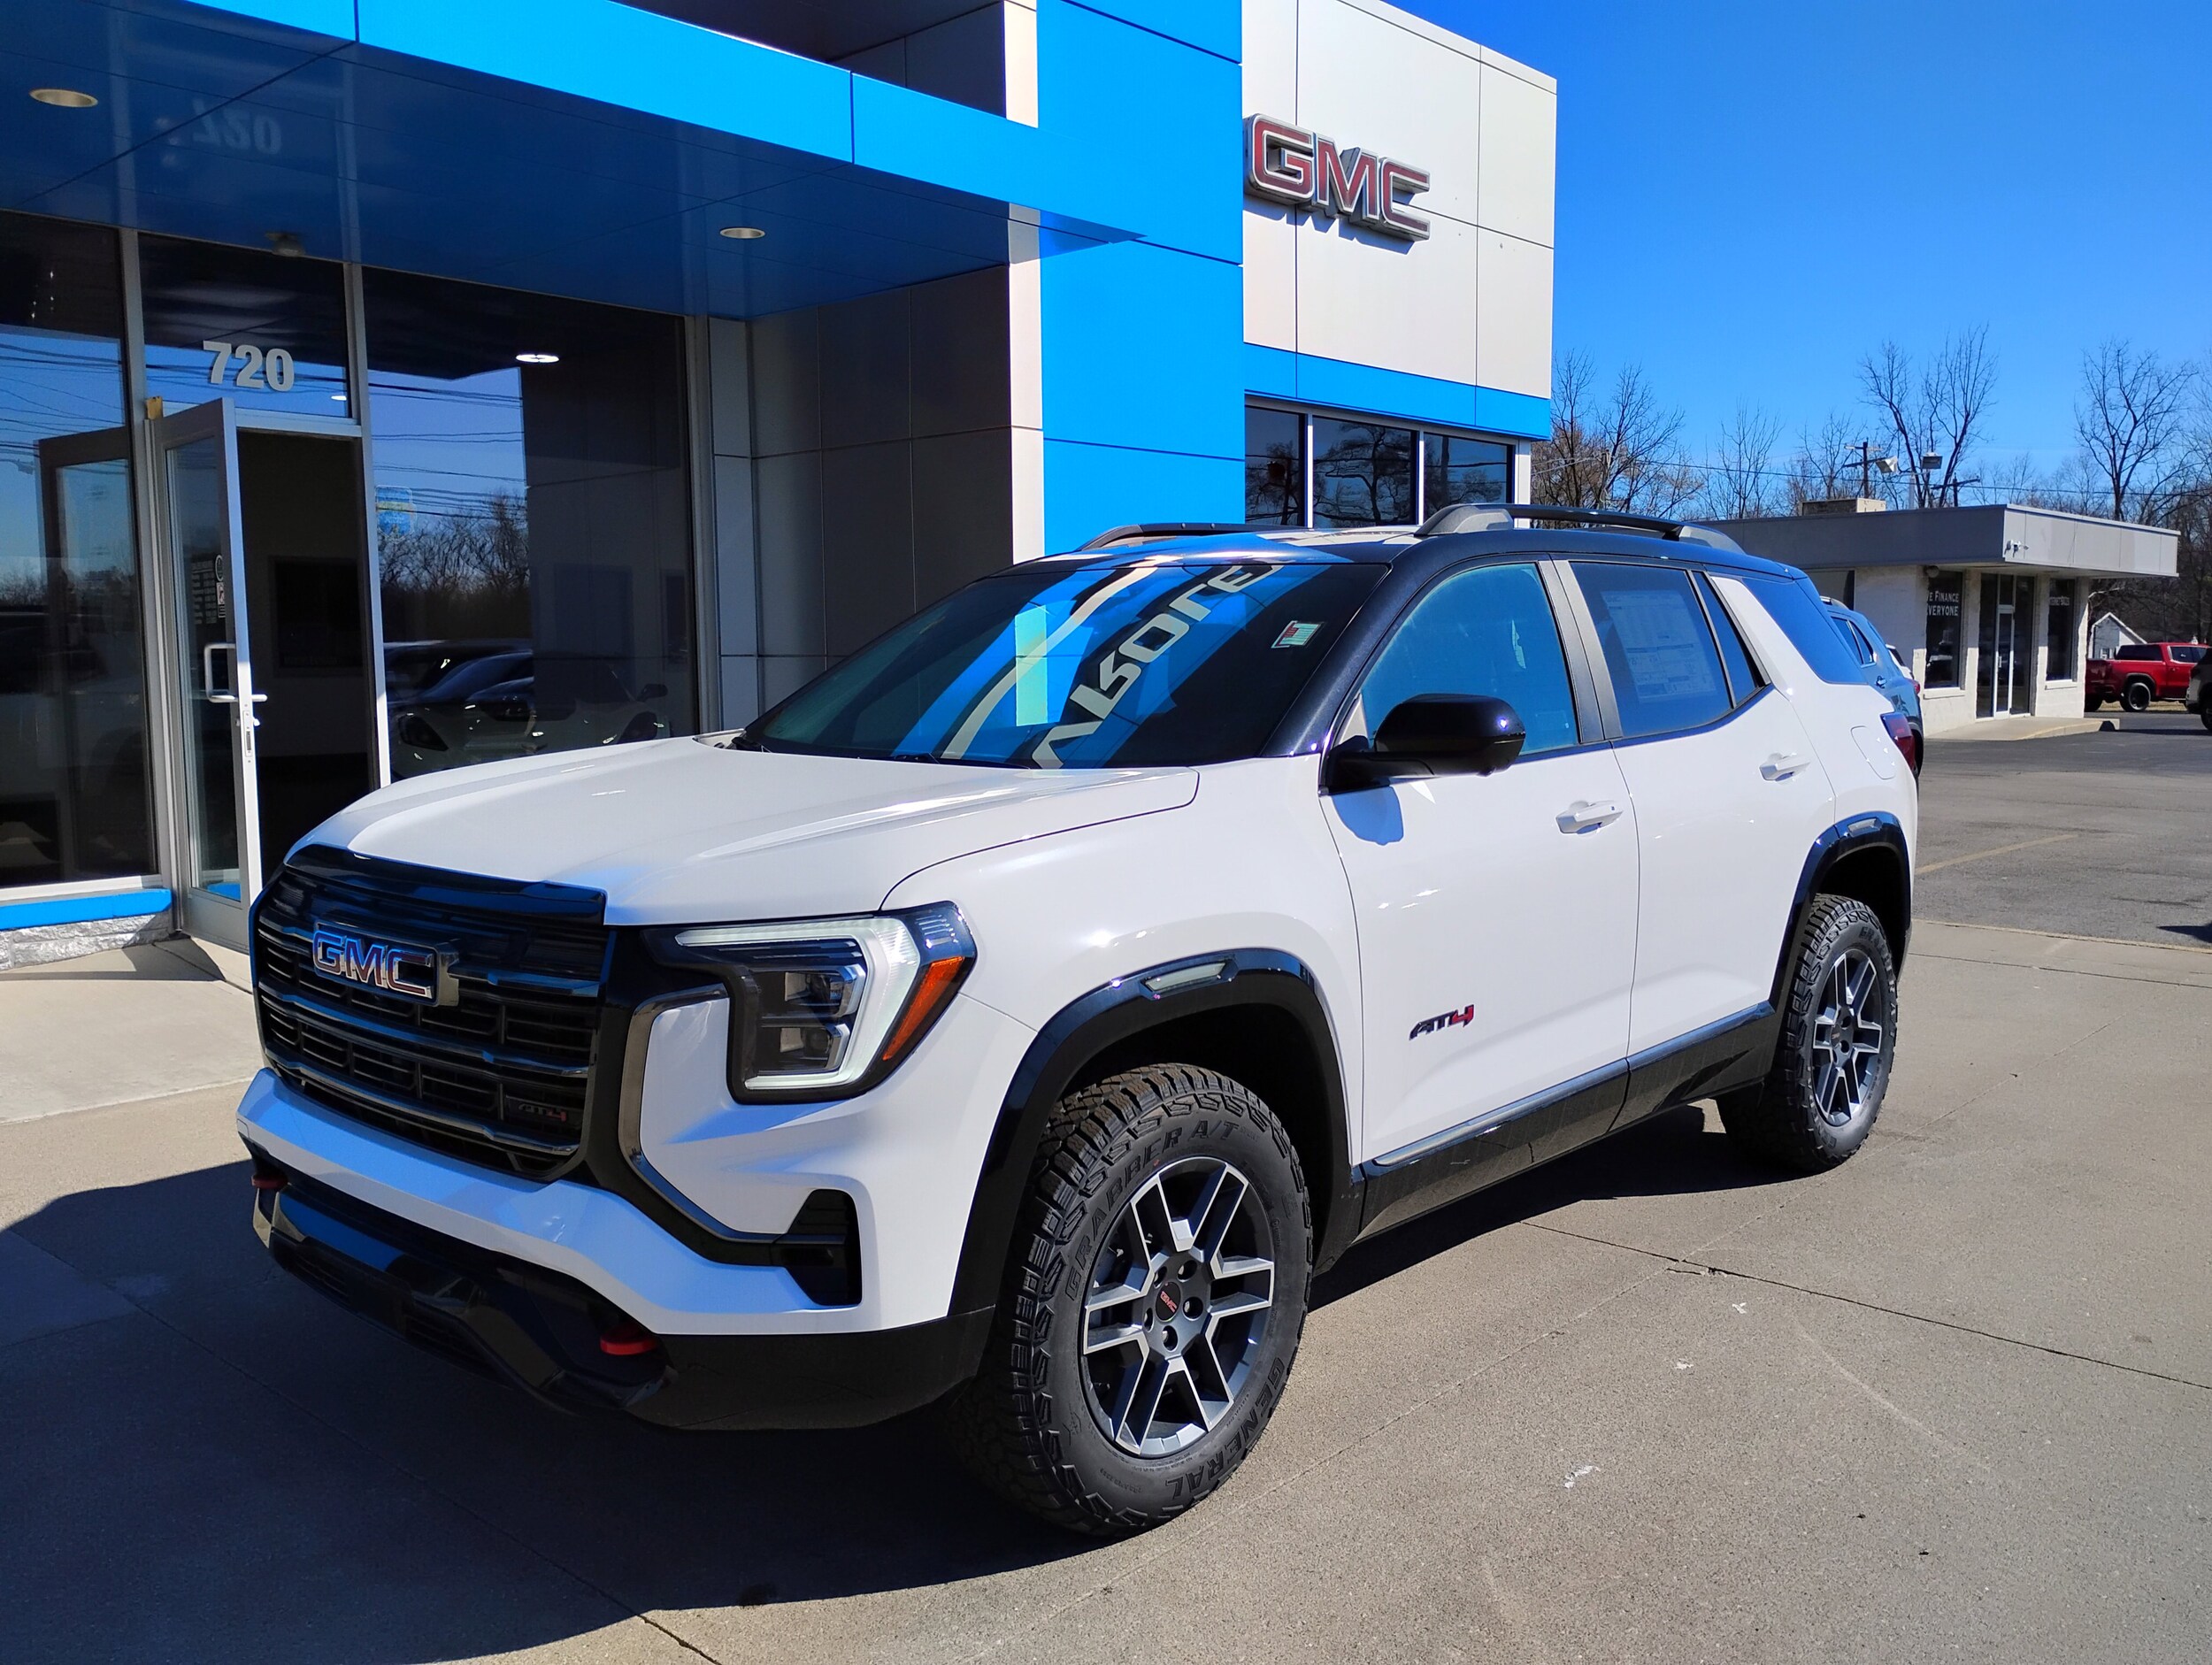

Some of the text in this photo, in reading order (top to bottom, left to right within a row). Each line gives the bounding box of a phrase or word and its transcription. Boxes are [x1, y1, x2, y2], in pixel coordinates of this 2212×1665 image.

[1243, 113, 1431, 241] GMC
[203, 340, 295, 392] 720
[1927, 605, 1959, 617] VERYONE
[1935, 590, 1959, 602] FINANCE
[312, 930, 436, 1000] GMC
[1409, 1004, 1474, 1040] AT4
[1064, 1119, 1240, 1301] GRABBER A/T
[1160, 1291, 1178, 1313] GMC
[1164, 1356, 1285, 1501] GENERAL
